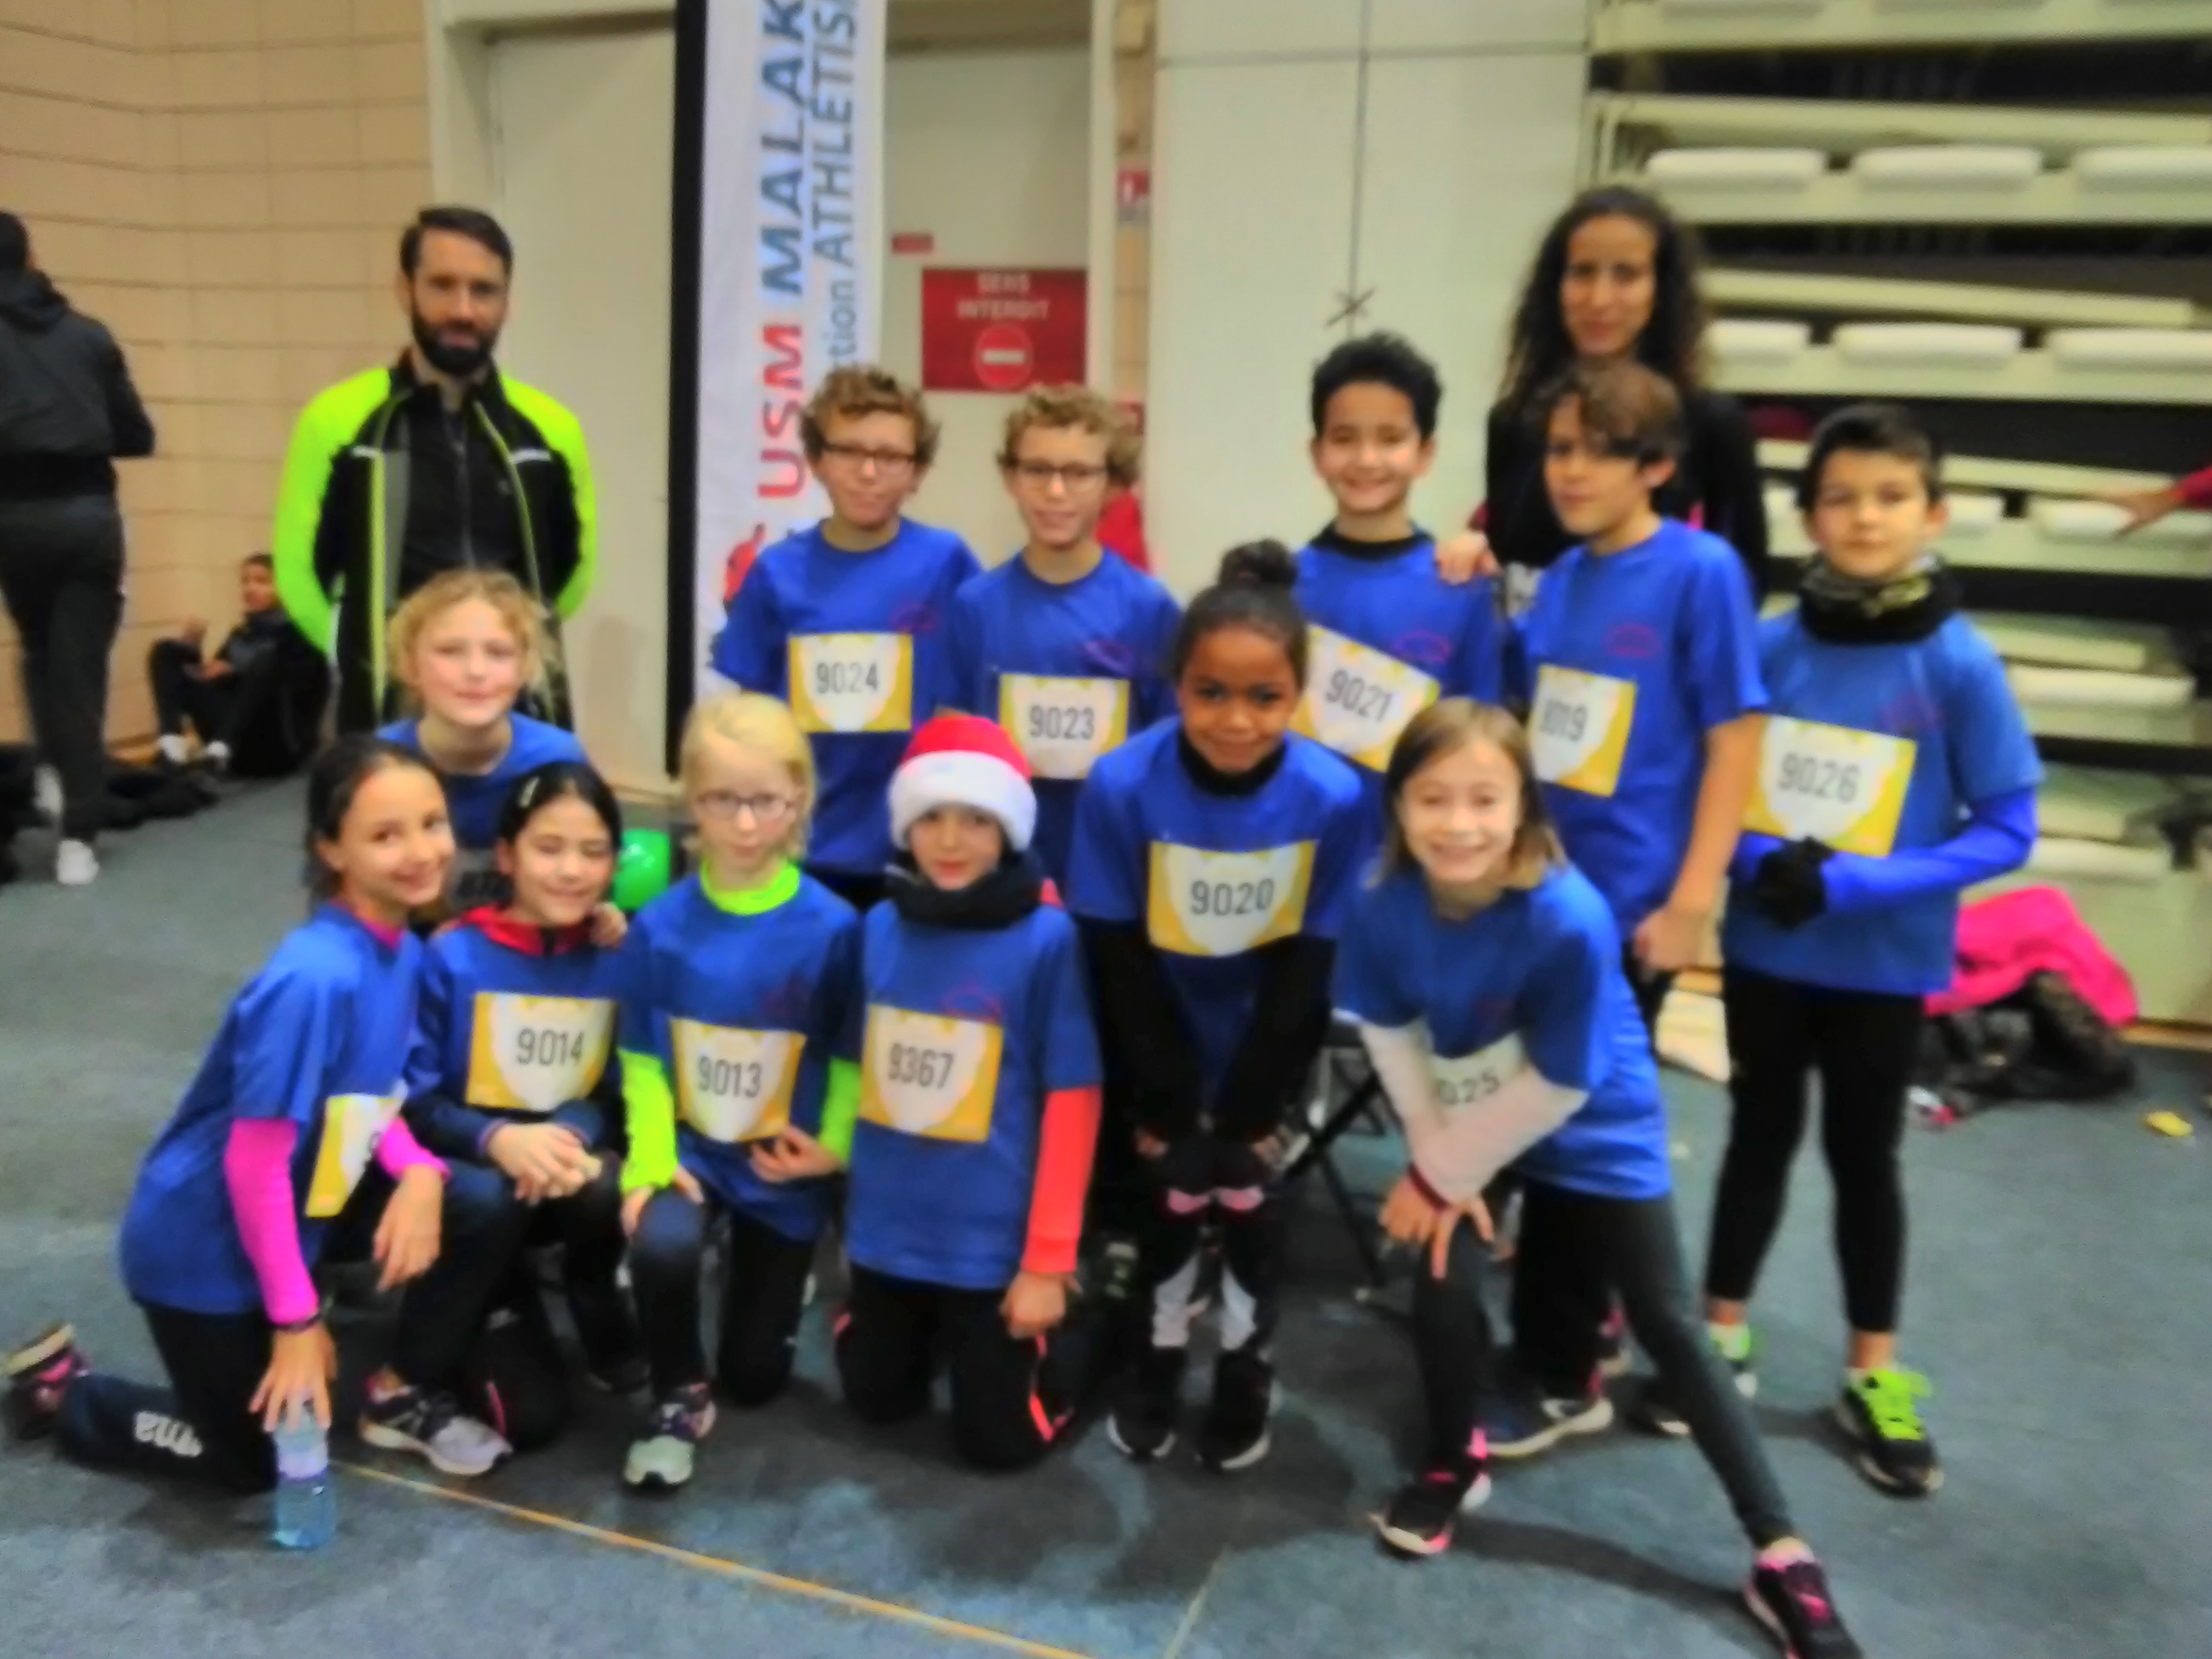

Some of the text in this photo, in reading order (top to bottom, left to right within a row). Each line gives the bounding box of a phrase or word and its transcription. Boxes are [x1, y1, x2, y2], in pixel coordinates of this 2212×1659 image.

[758, 0, 805, 499] USM MALAK
[823, 279, 857, 373] tion
[956, 300, 1050, 321] INTERDIT
[816, 662, 879, 695] 9024
[1325, 669, 1394, 723] 9021
[1029, 705, 1095, 741] 9023
[1778, 752, 1862, 804] 9026
[1191, 878, 1274, 917] 9020
[516, 1027, 585, 1066] 9014
[889, 1043, 954, 1090] 9367
[698, 1055, 762, 1099] 9013
